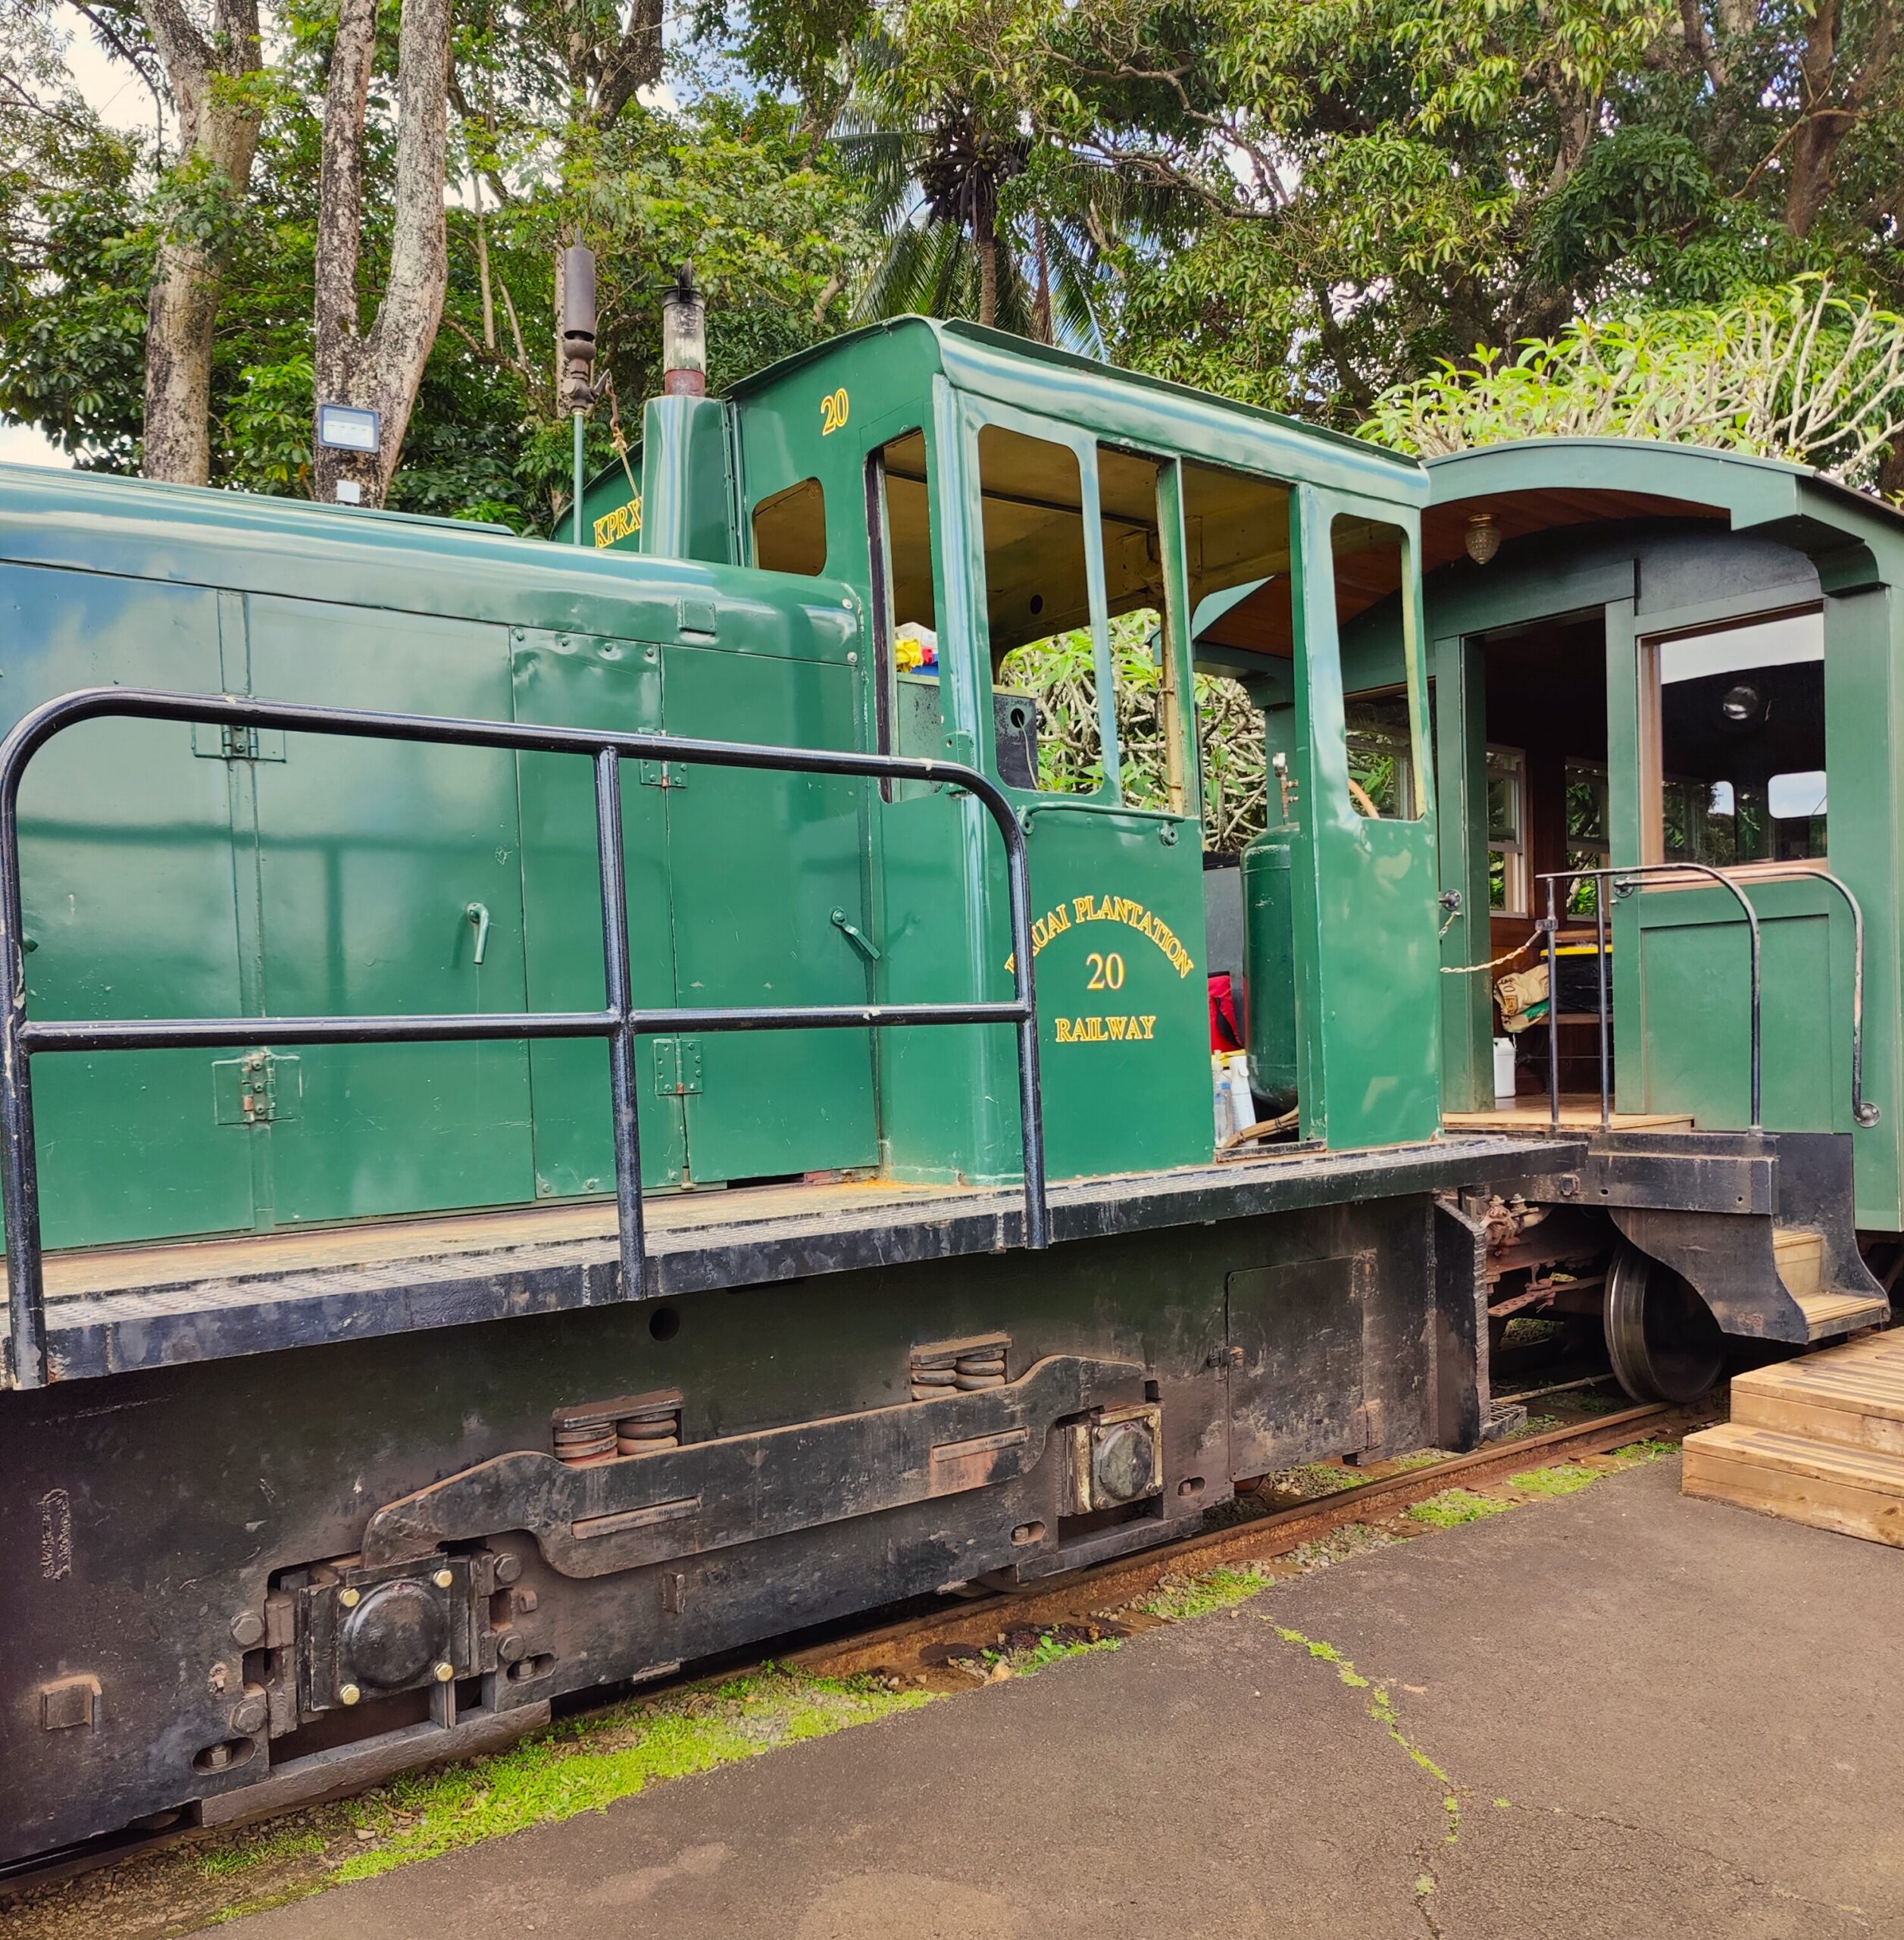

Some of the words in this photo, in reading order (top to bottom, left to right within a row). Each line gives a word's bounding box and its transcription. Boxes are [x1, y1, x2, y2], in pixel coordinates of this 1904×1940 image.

[821, 387, 849, 436] 20
[593, 496, 642, 549] KPRX
[1004, 903, 1071, 974] UAI
[1073, 895, 1194, 979] PLANTATION
[1086, 953, 1125, 990] 20
[1055, 1015, 1156, 1043] RAILWAY
